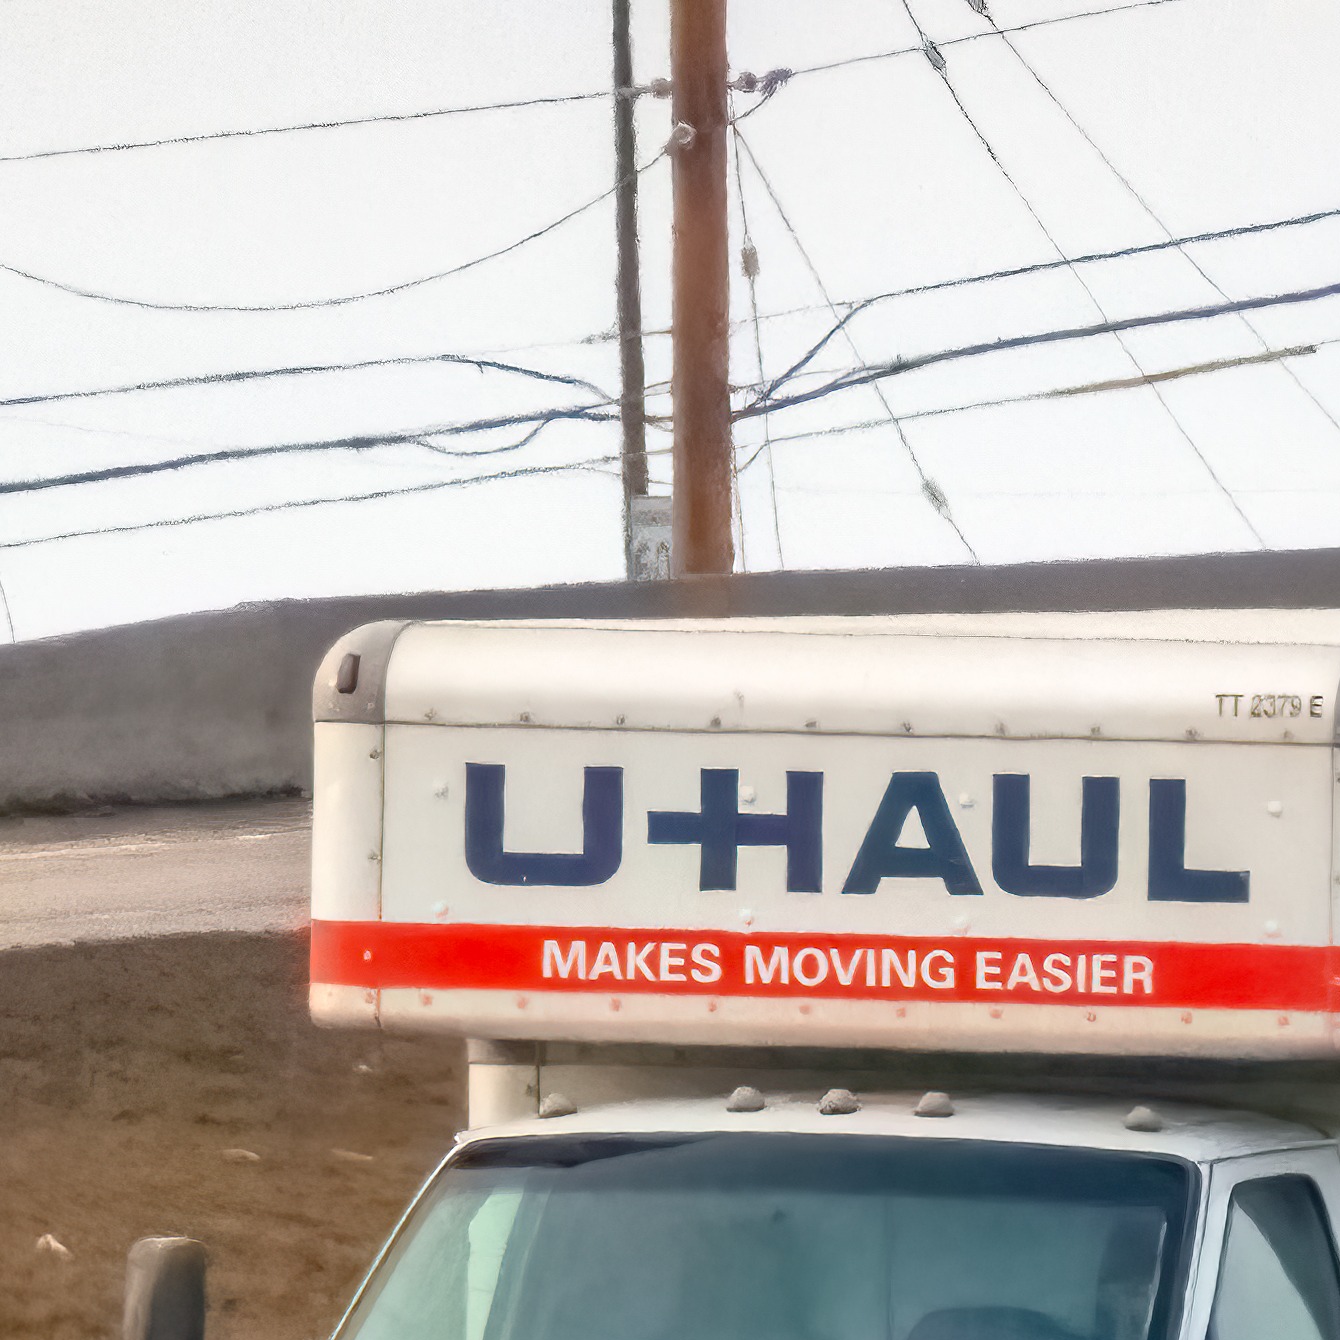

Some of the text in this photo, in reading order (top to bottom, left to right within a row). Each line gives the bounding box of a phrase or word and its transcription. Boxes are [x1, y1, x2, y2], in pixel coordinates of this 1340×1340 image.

[1215, 694, 1244, 717] TT
[1309, 695, 1324, 718] E
[465, 762, 1250, 904] U-HAUL
[542, 939, 1154, 995] MAKES MOVING EASIER
